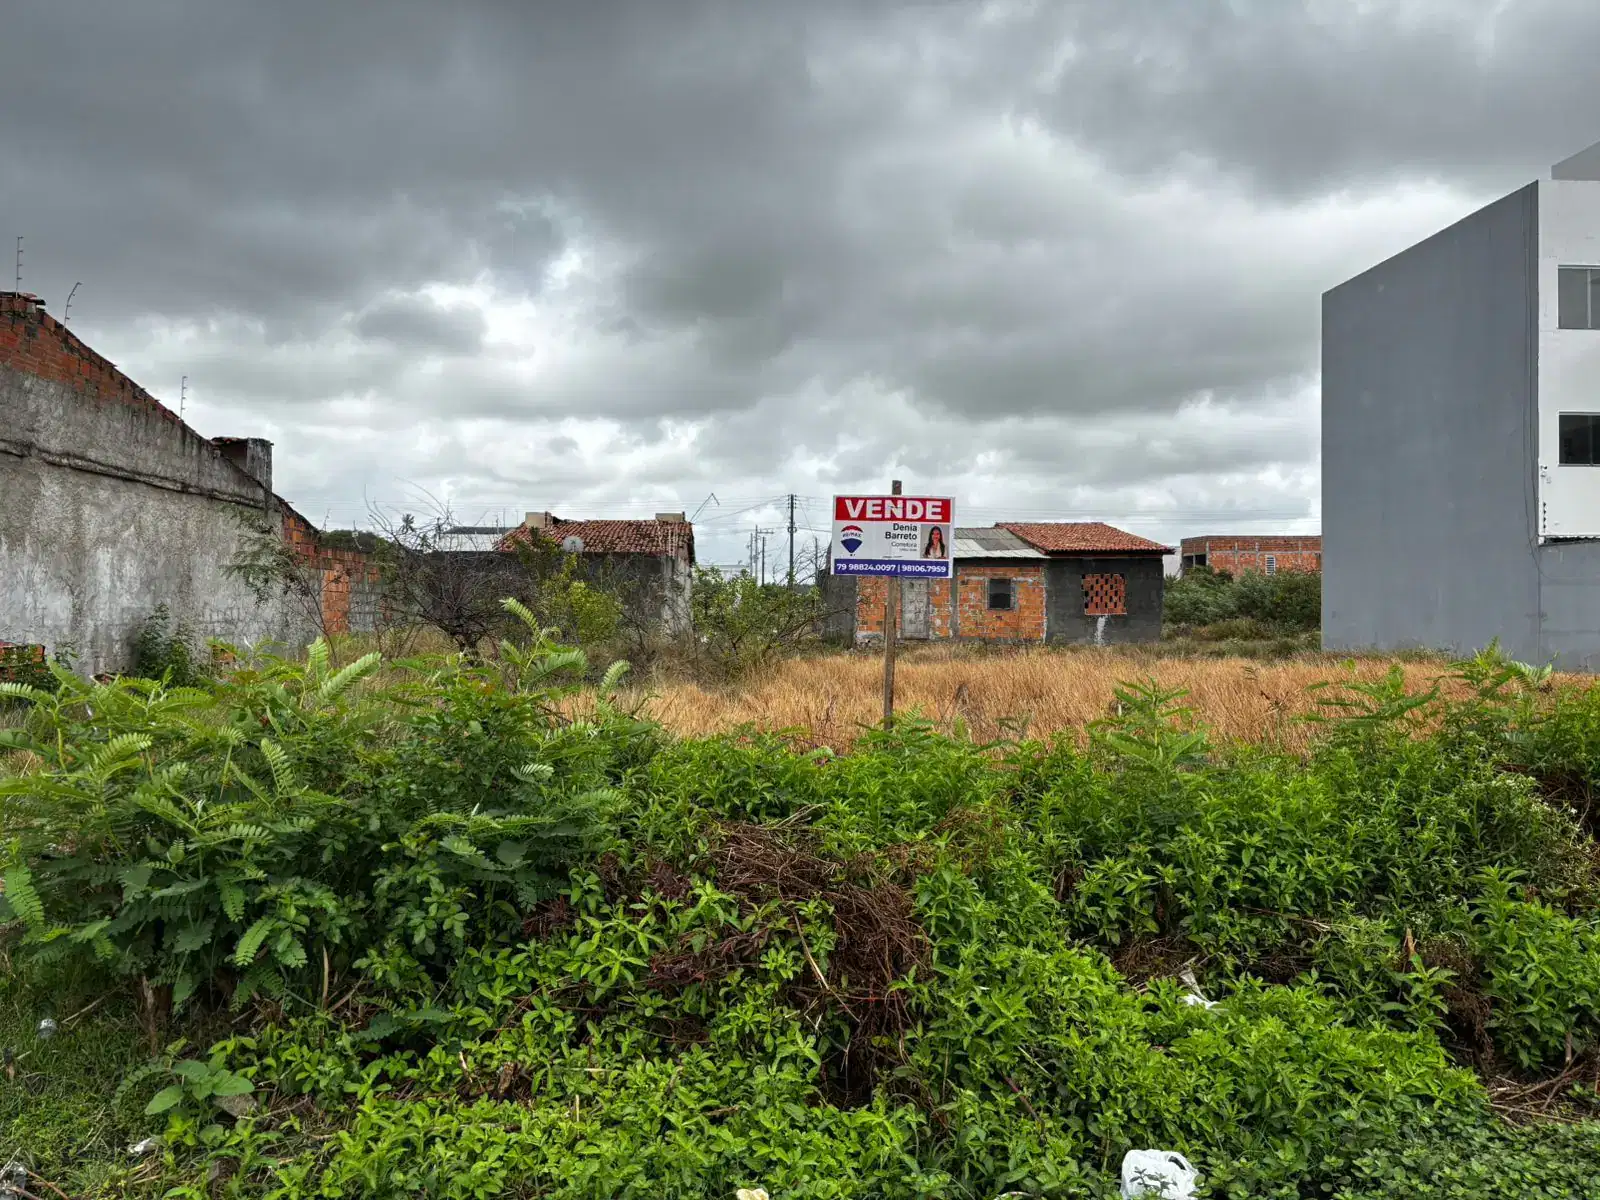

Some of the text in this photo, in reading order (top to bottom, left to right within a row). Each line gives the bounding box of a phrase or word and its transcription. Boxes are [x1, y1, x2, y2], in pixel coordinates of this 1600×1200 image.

[845, 499, 942, 520] VENDE
[885, 531, 917, 540] Barreto
[836, 563, 847, 571] 79
[849, 563, 896, 572] 98824.0097
[902, 564, 946, 573] 98106.7959
